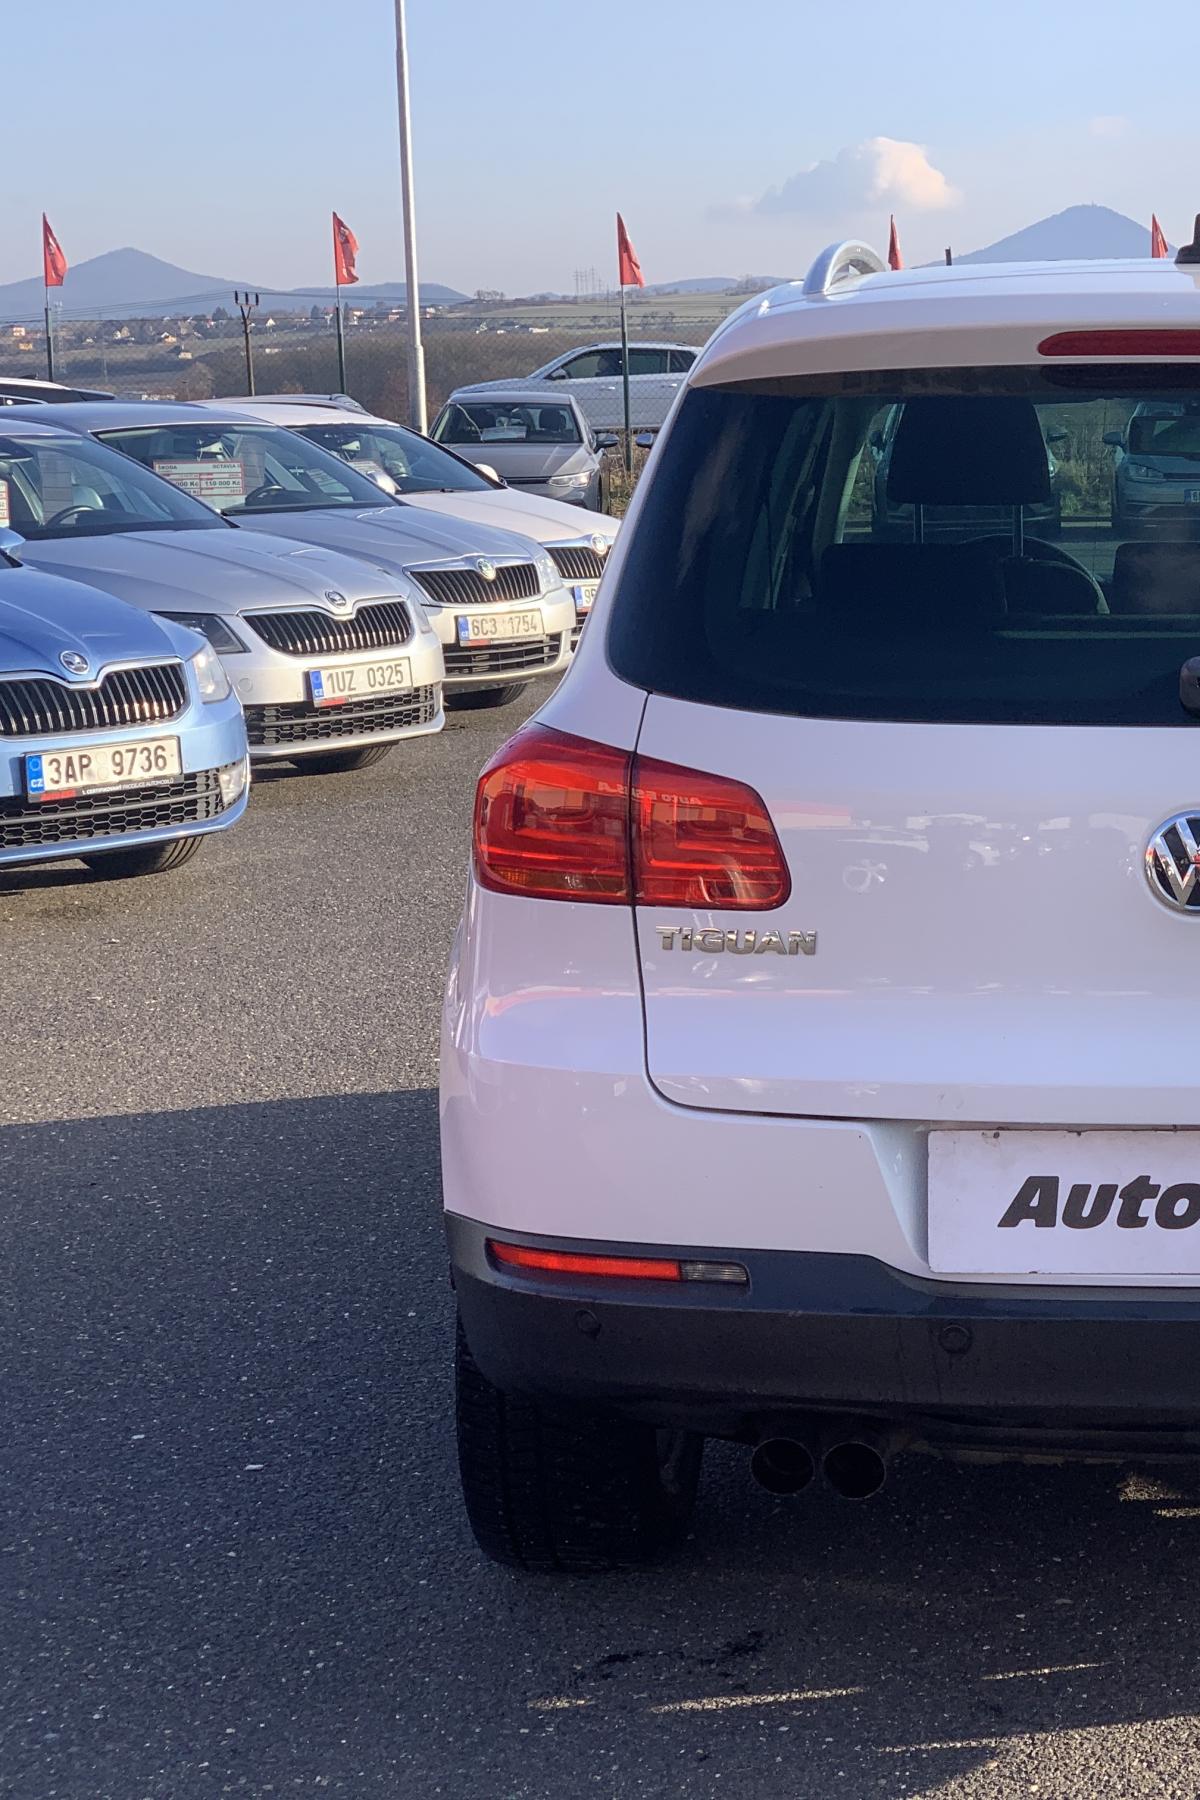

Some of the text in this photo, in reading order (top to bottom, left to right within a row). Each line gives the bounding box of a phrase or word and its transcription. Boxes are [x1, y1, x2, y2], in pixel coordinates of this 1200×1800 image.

[471, 618, 498, 636] 6C3
[507, 614, 538, 635] 1754
[326, 669, 357, 694] 1UZ
[366, 663, 404, 688] 0325
[30, 744, 168, 788] CZ 3AP 9736
[655, 926, 817, 956] TIGUAN
